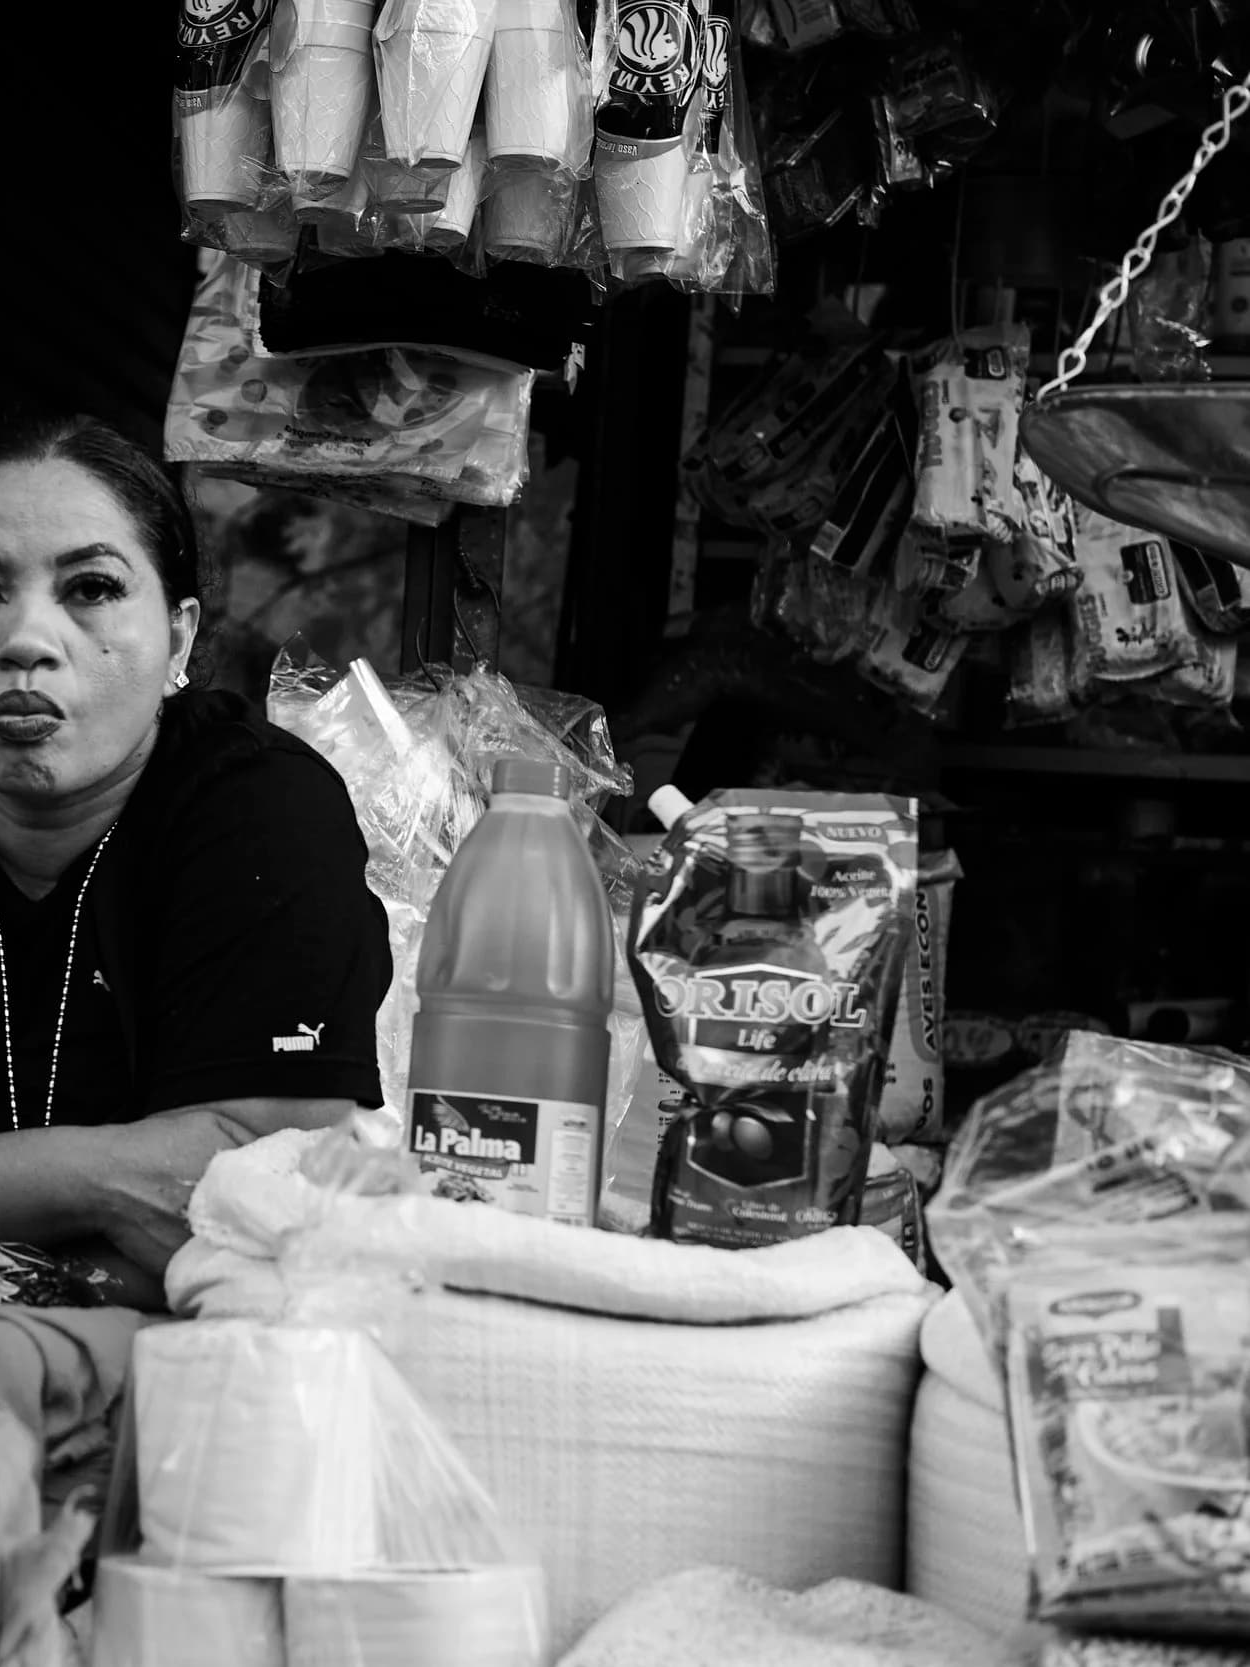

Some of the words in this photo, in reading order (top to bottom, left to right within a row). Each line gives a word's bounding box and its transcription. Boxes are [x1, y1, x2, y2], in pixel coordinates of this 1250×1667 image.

[612, 63, 690, 94] REYM
[827, 826, 882, 838] NUEVO
[654, 975, 867, 1028] ORISOL
[921, 978, 936, 1052] AVES
[736, 1028, 777, 1051] Life
[414, 1124, 437, 1152] La
[439, 1127, 521, 1161] Palma
